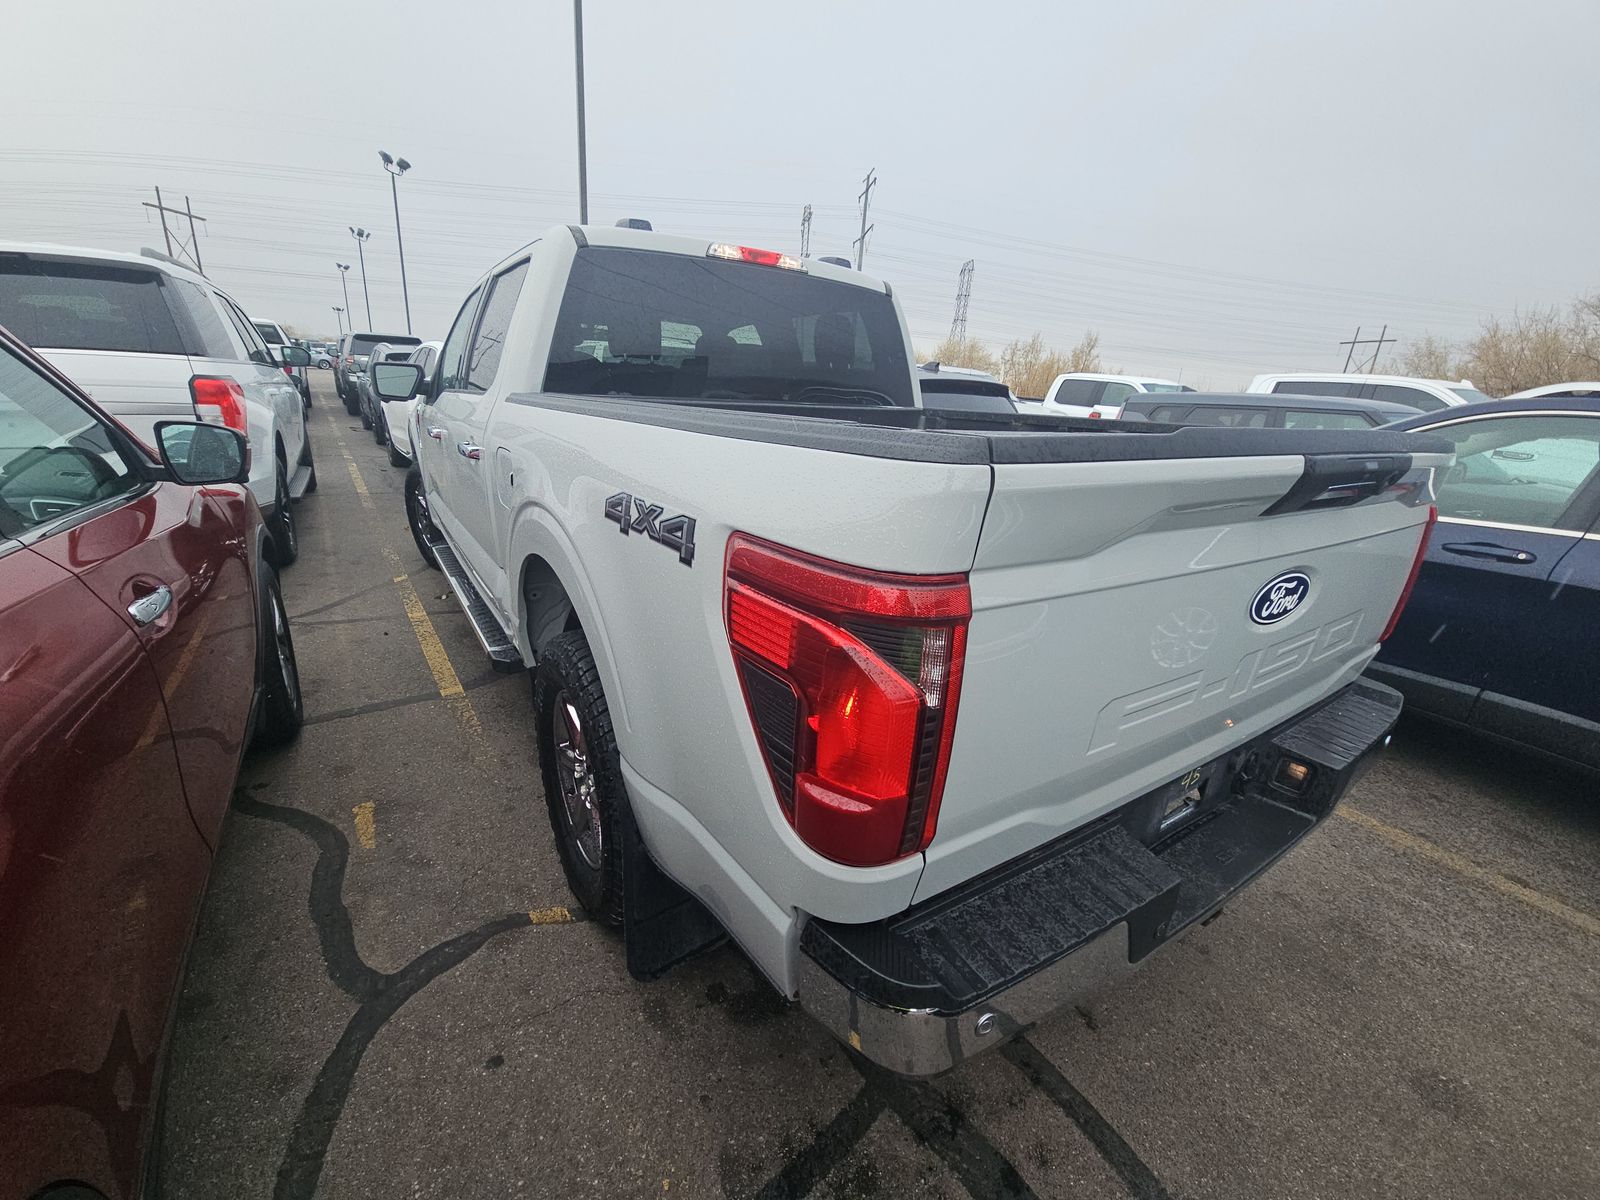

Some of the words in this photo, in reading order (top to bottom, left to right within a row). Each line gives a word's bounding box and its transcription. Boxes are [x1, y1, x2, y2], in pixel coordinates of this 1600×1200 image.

[1261, 581, 1304, 617] Ford
[1086, 609, 1365, 756] F-150
[1181, 767, 1201, 789] 45
